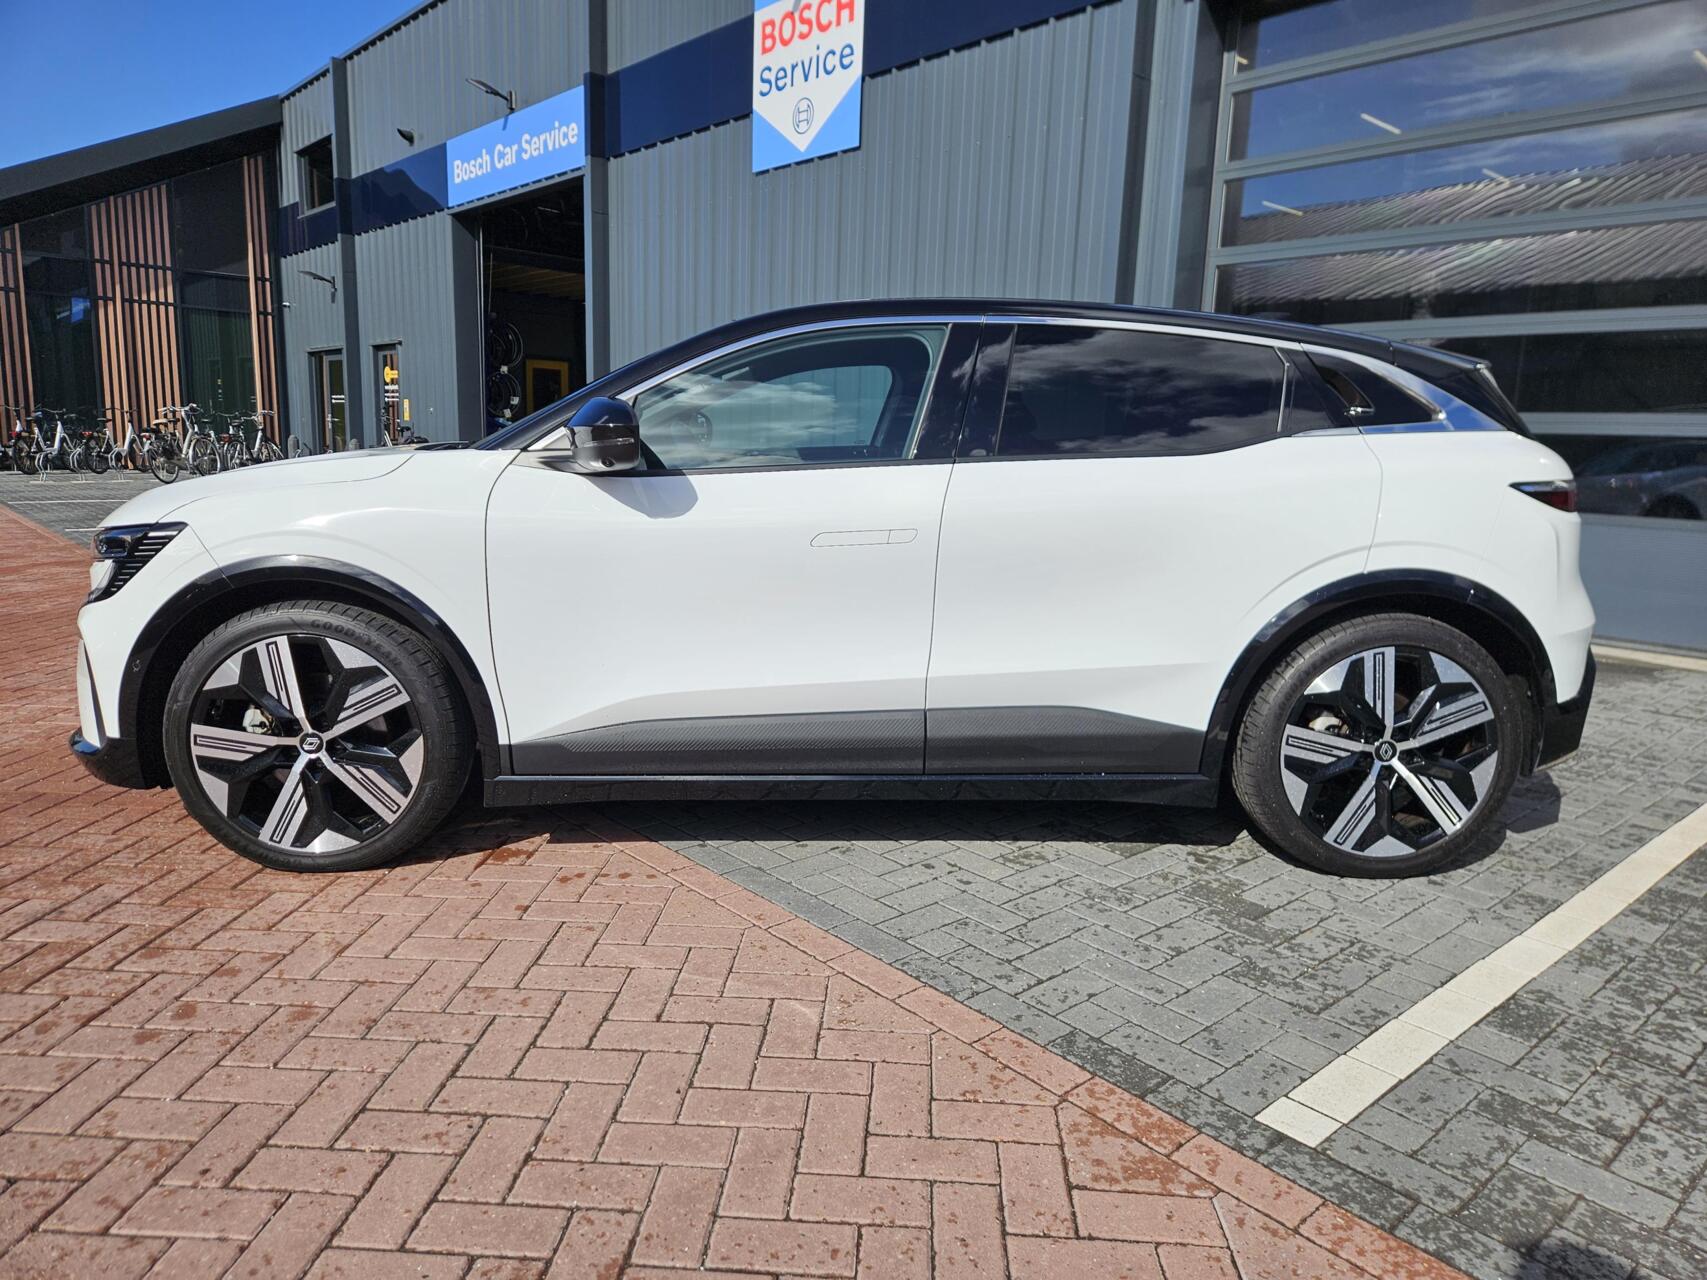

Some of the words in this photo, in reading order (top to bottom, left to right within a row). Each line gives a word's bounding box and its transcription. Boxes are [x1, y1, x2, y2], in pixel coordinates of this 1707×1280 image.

[761, 0, 856, 56] BOSCH
[759, 43, 855, 97] Service
[453, 149, 491, 184] Bosch
[494, 143, 519, 169] Car
[521, 120, 579, 160] Service
